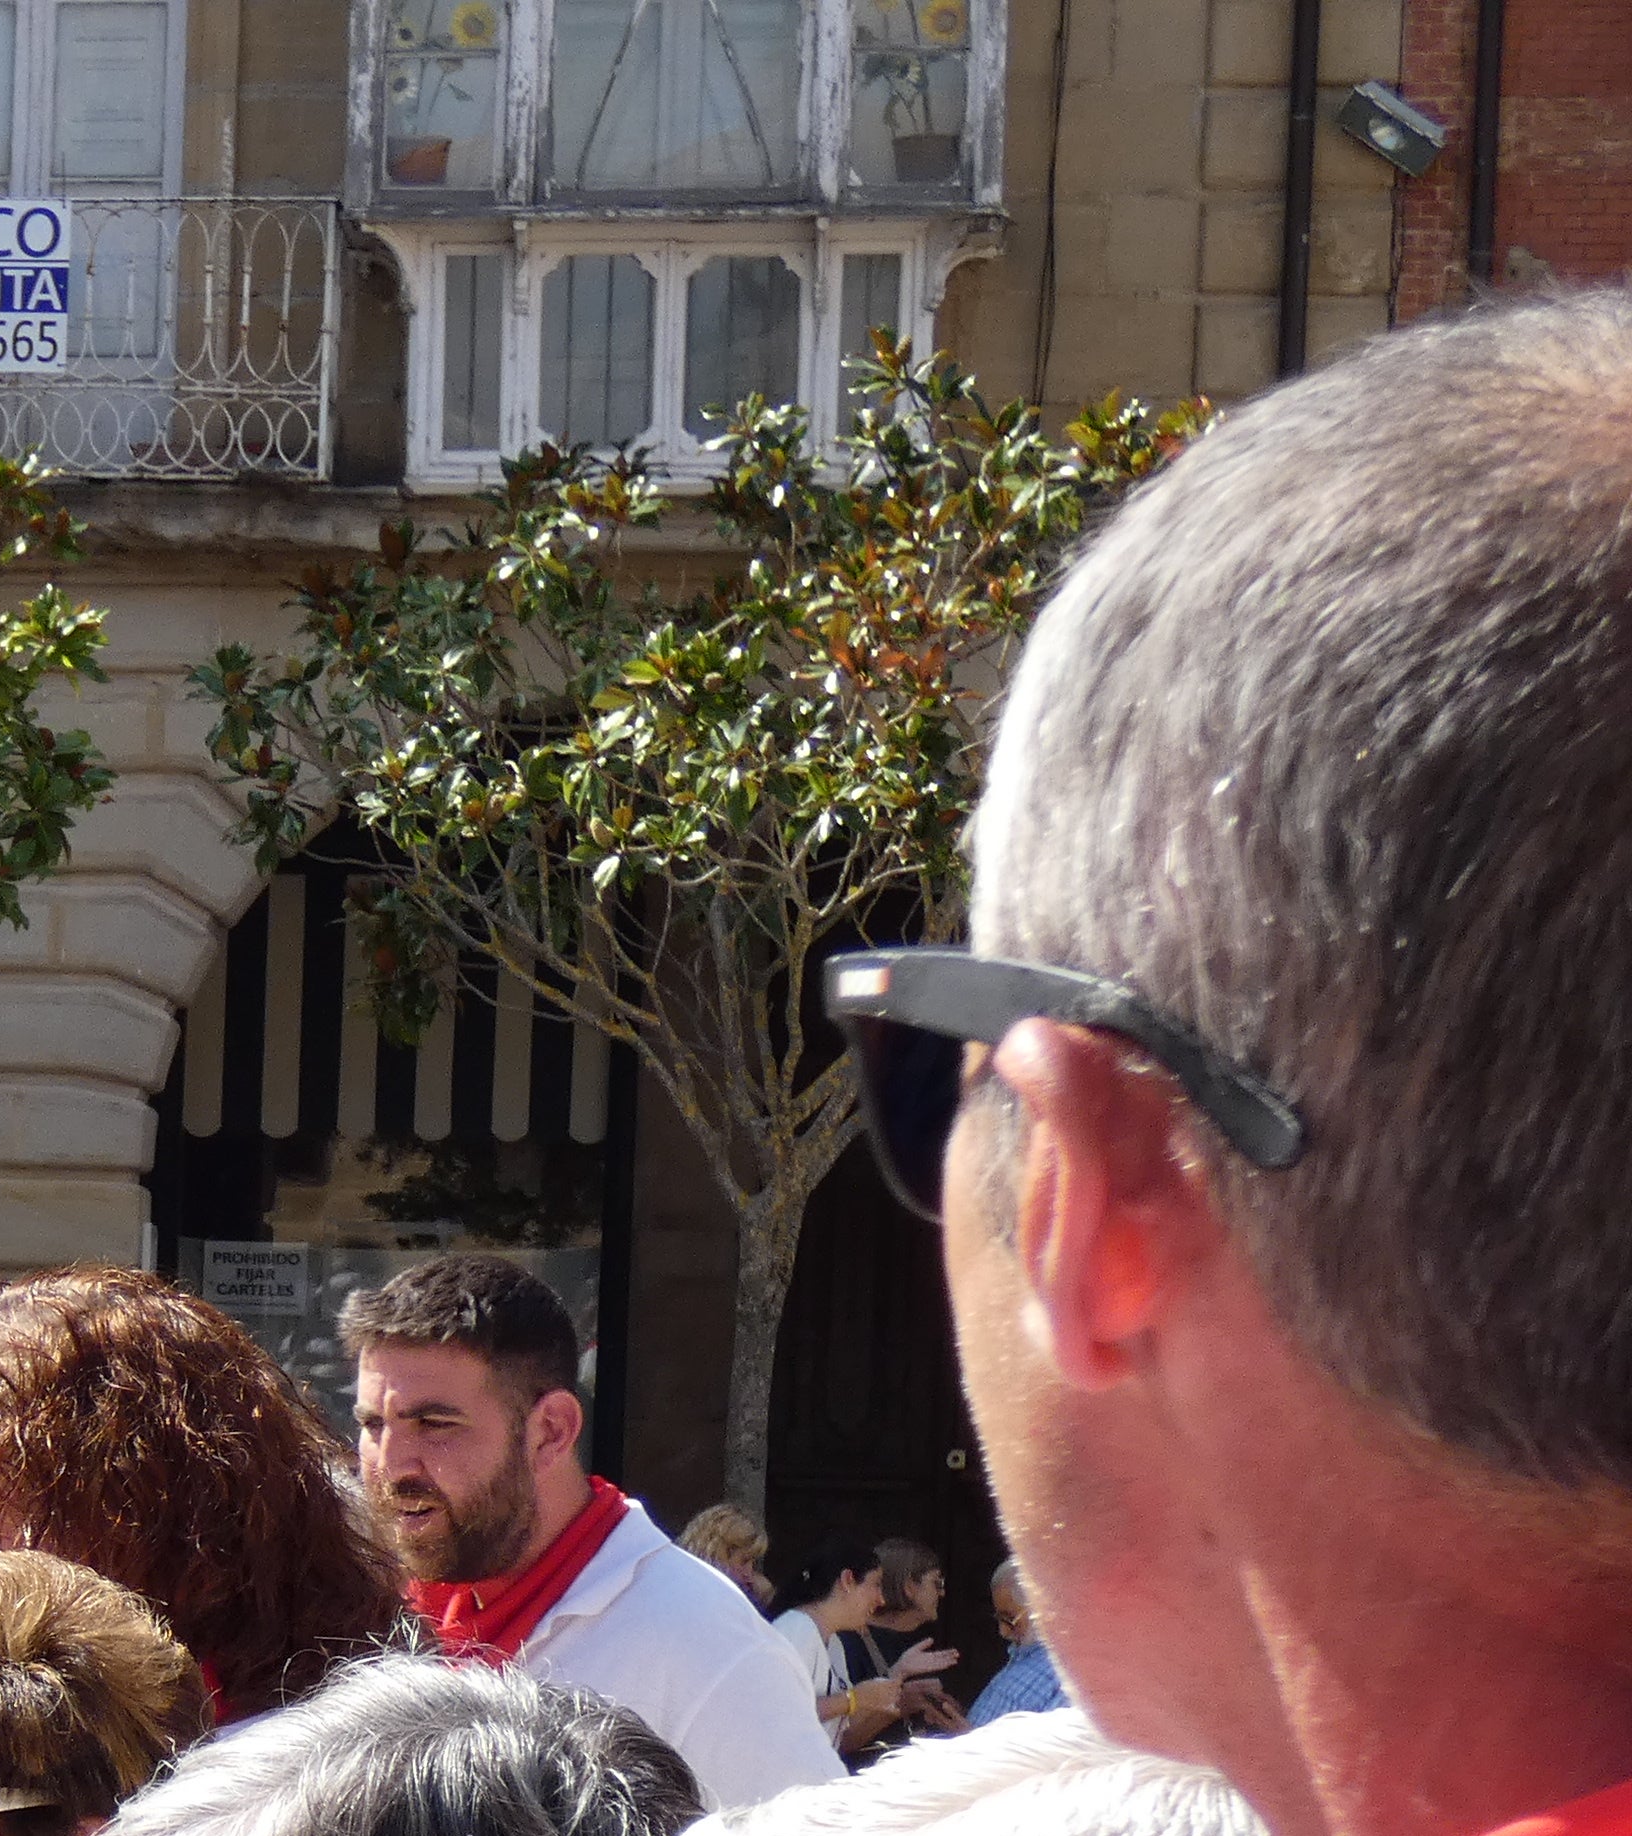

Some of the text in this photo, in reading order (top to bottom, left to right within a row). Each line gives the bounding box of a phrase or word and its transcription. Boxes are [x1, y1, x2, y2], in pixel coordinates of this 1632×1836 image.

[212, 1251, 301, 1266] PROHIBIDO
[236, 1267, 276, 1282] FIJAR
[216, 1282, 295, 1298] CARTELES
